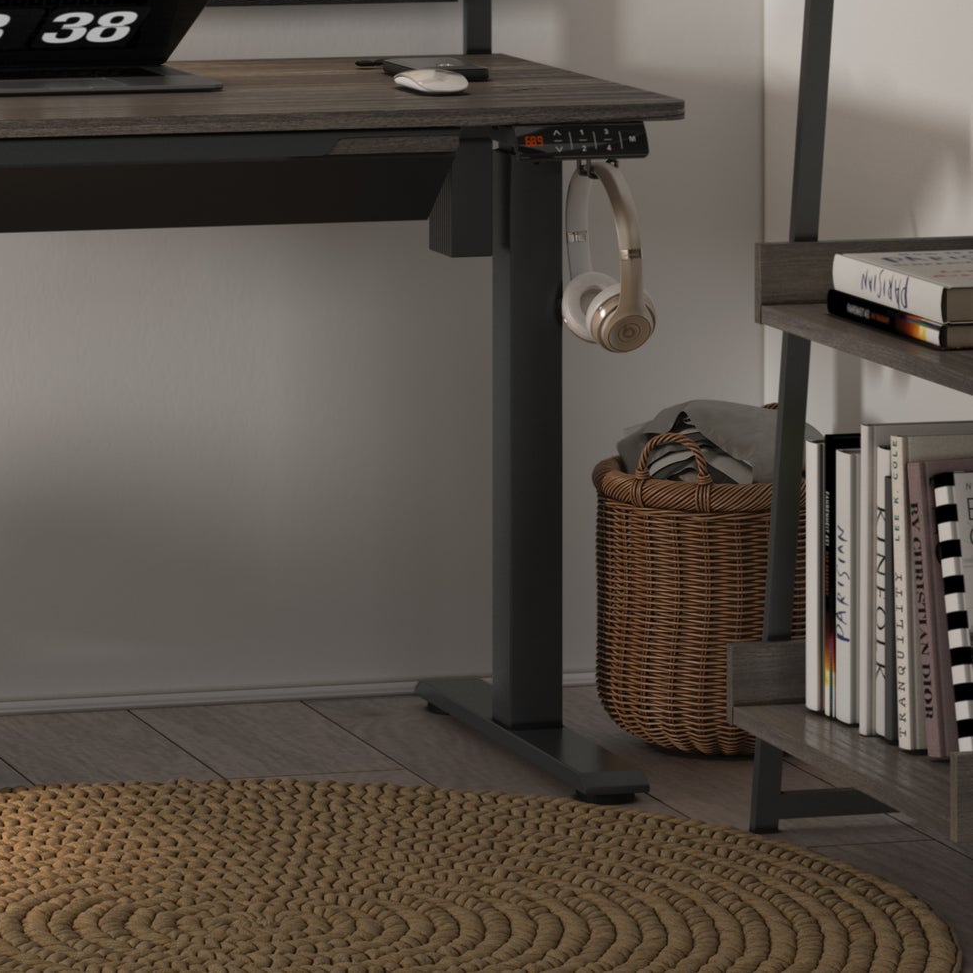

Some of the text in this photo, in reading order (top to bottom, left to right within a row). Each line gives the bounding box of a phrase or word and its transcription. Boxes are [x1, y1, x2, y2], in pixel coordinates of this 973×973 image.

[41, 10, 139, 44] 38
[860, 268, 910, 310] PARISIAN
[894, 513, 902, 542] LEE
[836, 525, 851, 643] PARISIAN
[895, 574, 907, 739] TRANQUILITY
[913, 537, 930, 656] CHRISTIAN
[922, 663, 934, 719] DIOR
